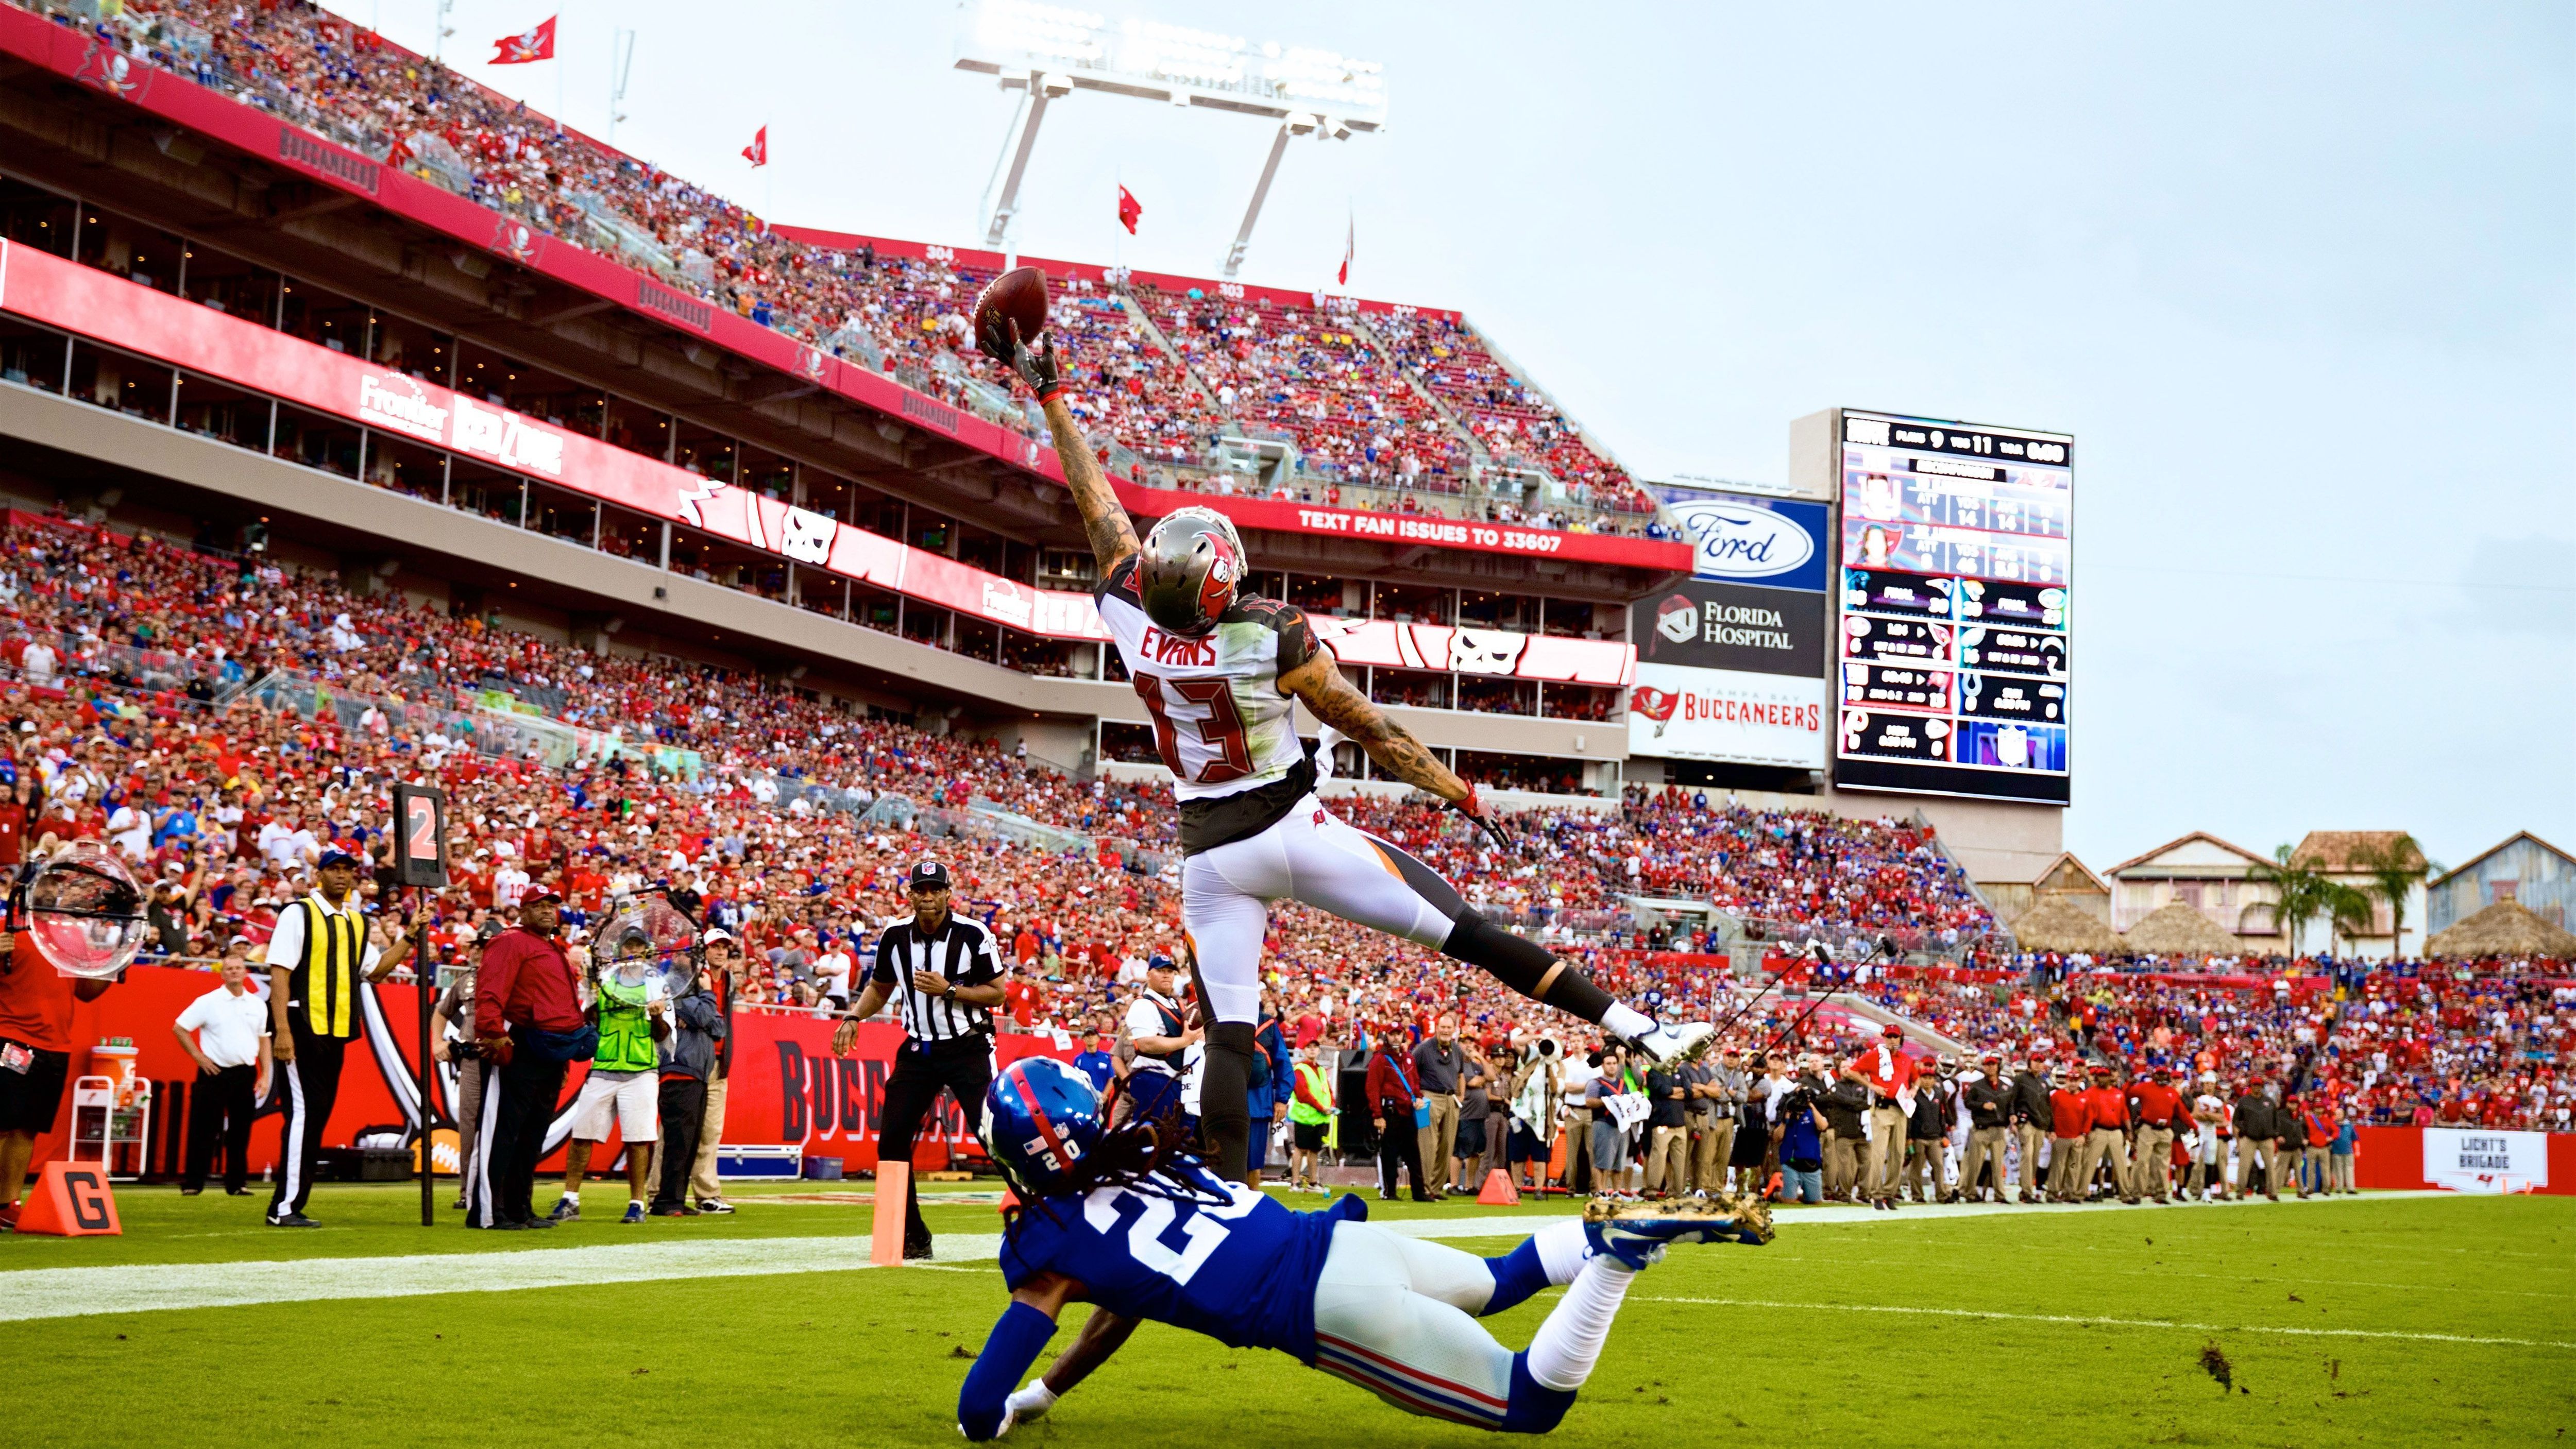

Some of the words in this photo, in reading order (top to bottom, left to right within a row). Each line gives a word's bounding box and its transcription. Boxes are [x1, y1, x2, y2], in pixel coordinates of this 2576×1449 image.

[926, 245, 954, 261] 304
[1218, 283, 1244, 298] 303
[1930, 431, 1944, 448] 9
[1972, 435, 1991, 454] 11
[1917, 492, 1939, 505] ATT
[1299, 509, 1350, 531] TEXT
[1354, 516, 1394, 536] FAN
[1399, 520, 1467, 543] ISSUES
[1472, 529, 1498, 545] TO
[1503, 531, 1562, 552] 33607
[1922, 506, 1930, 521] 1
[1958, 509, 1977, 526] 14
[1997, 514, 2016, 531] 14
[1687, 513, 1774, 562] Ford
[1916, 540, 1938, 553] ATT
[1704, 601, 1783, 627] FLORIDA
[1140, 625, 1218, 667] EVANS
[1704, 623, 1793, 650] HOSPITAL
[1706, 687, 1759, 698] TAMPA
[1685, 693, 1819, 731] BUCCANEERS
[1133, 670, 1256, 783] 13
[408, 796, 436, 860] 2
[1042, 1139, 1081, 1172] 20
[2460, 1155, 2509, 1169] BRIGADE
[64, 1172, 110, 1229] G
